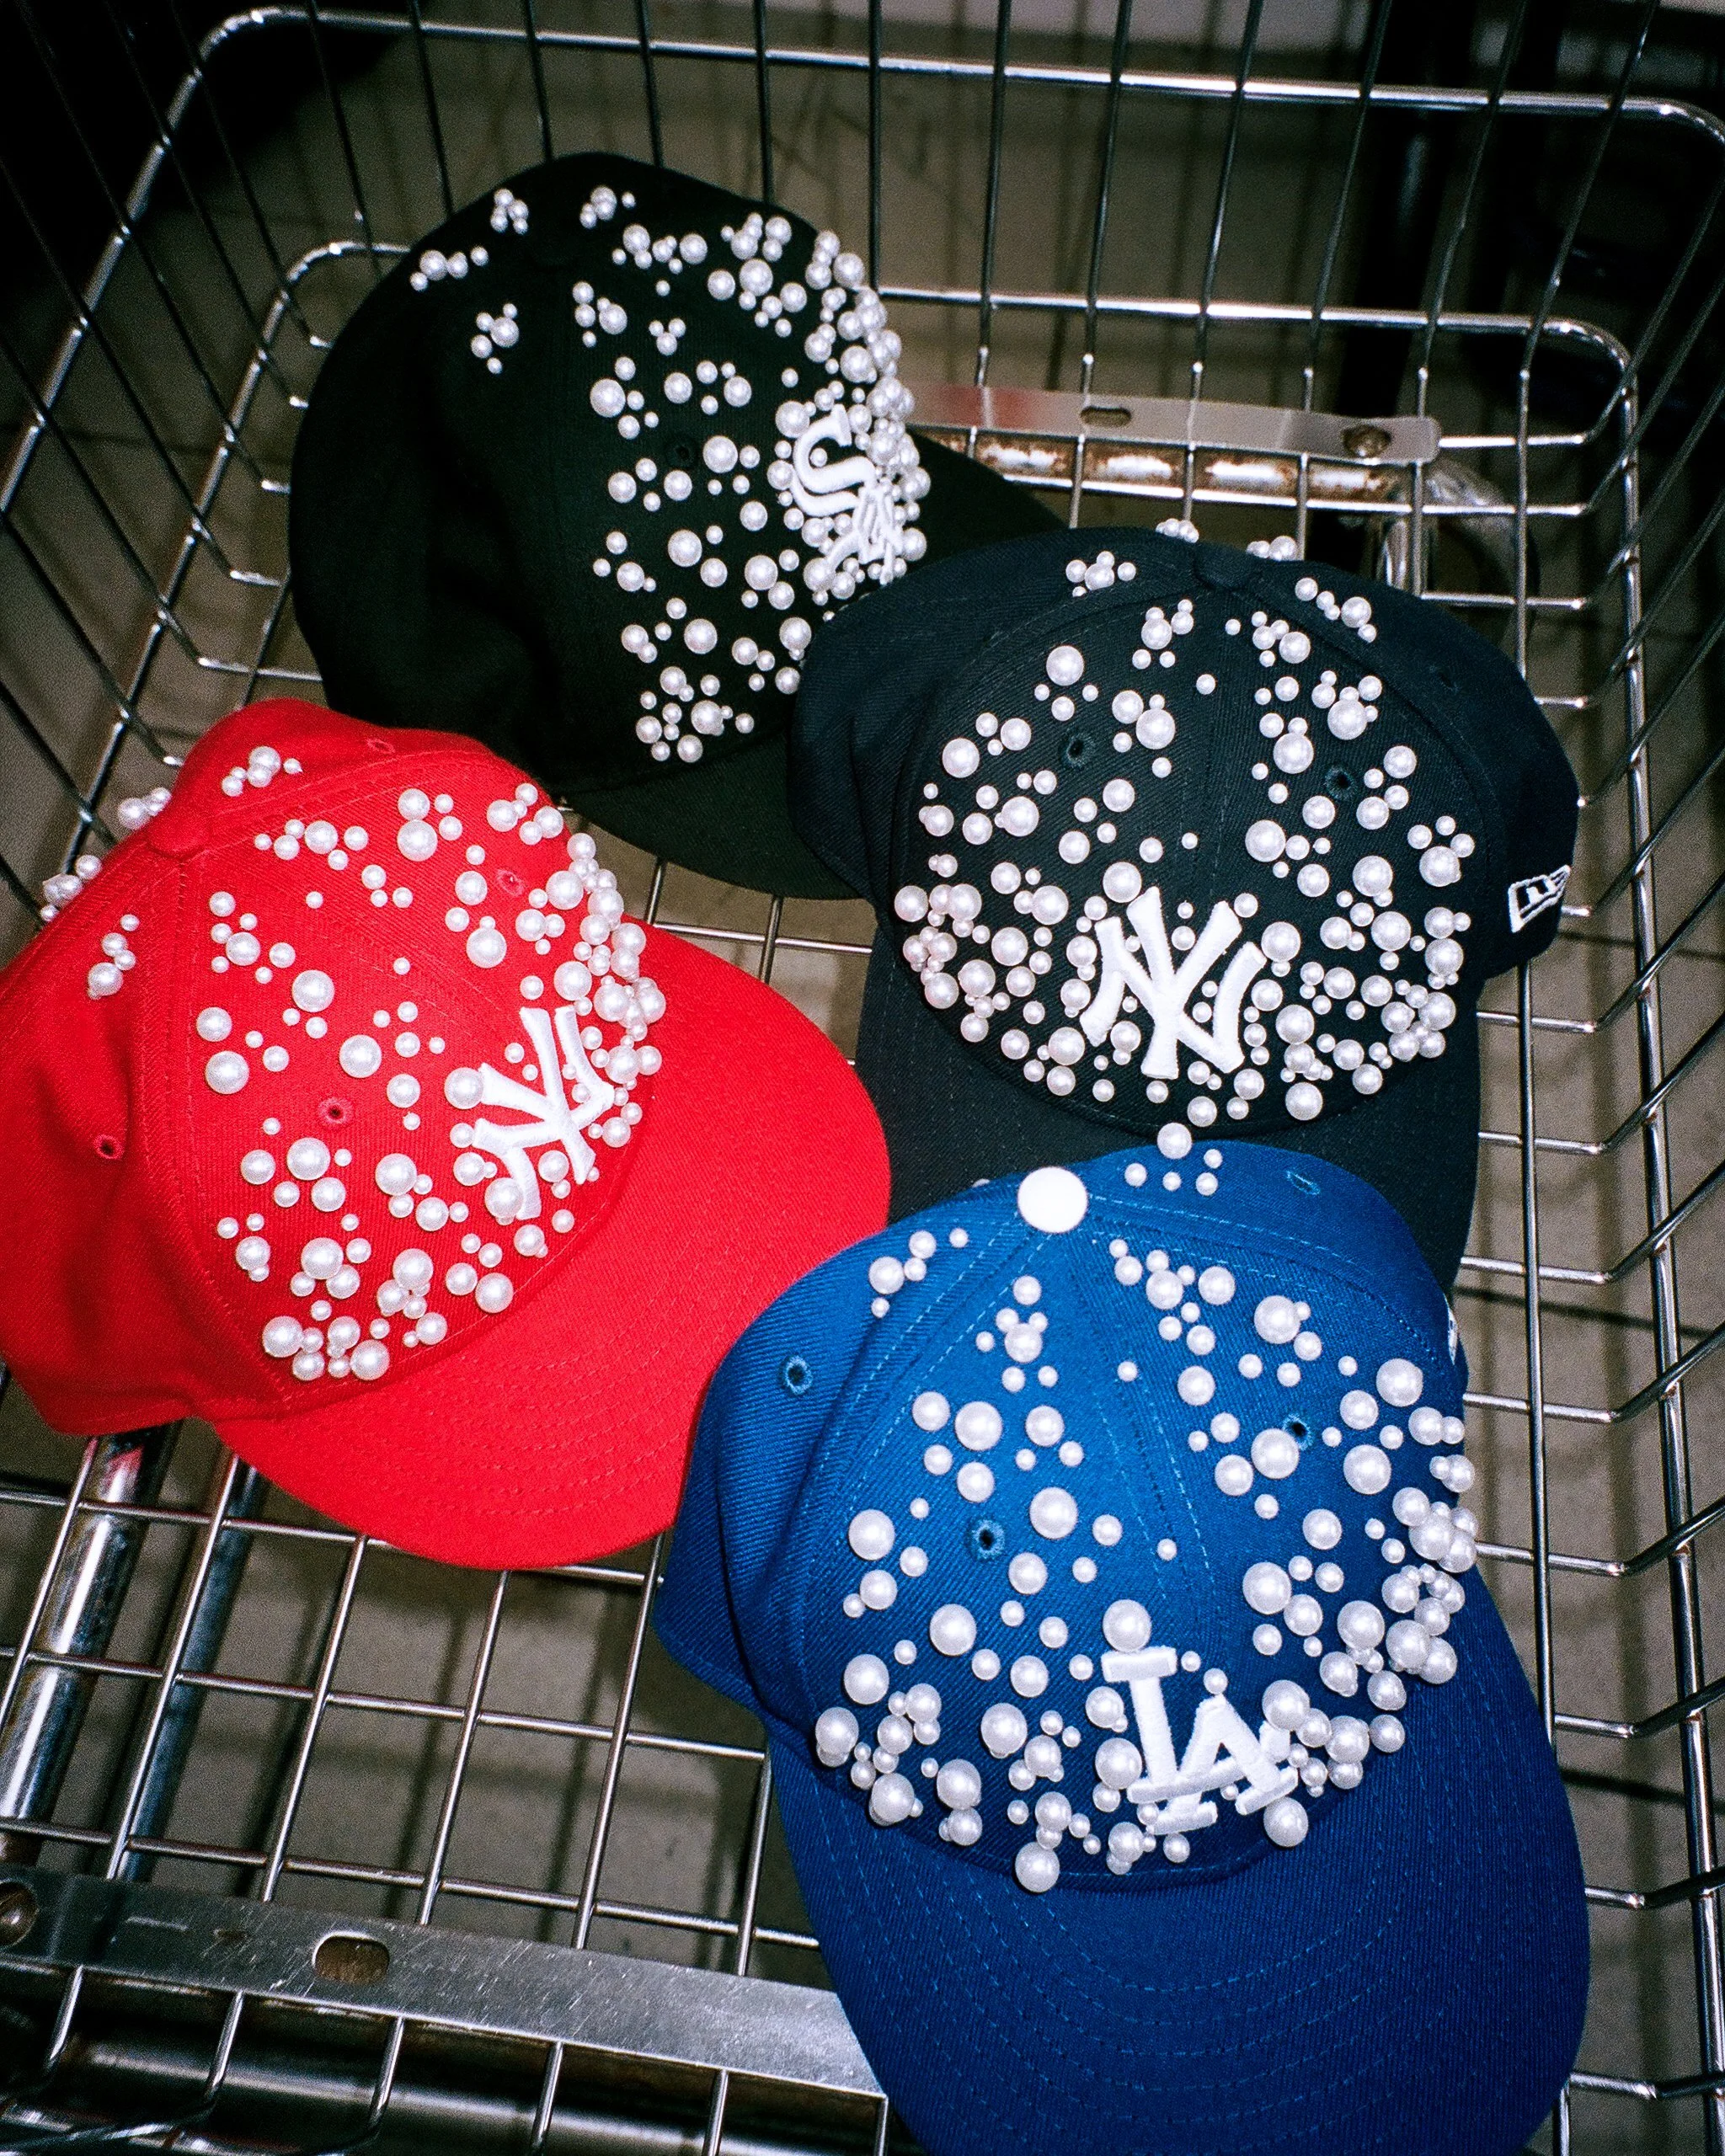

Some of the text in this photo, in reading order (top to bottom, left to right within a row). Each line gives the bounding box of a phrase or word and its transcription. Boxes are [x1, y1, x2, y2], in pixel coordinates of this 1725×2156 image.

[1080, 886, 1267, 1079] NY
[472, 1006, 615, 1220] NY
[1101, 1646, 1298, 1835] LA
